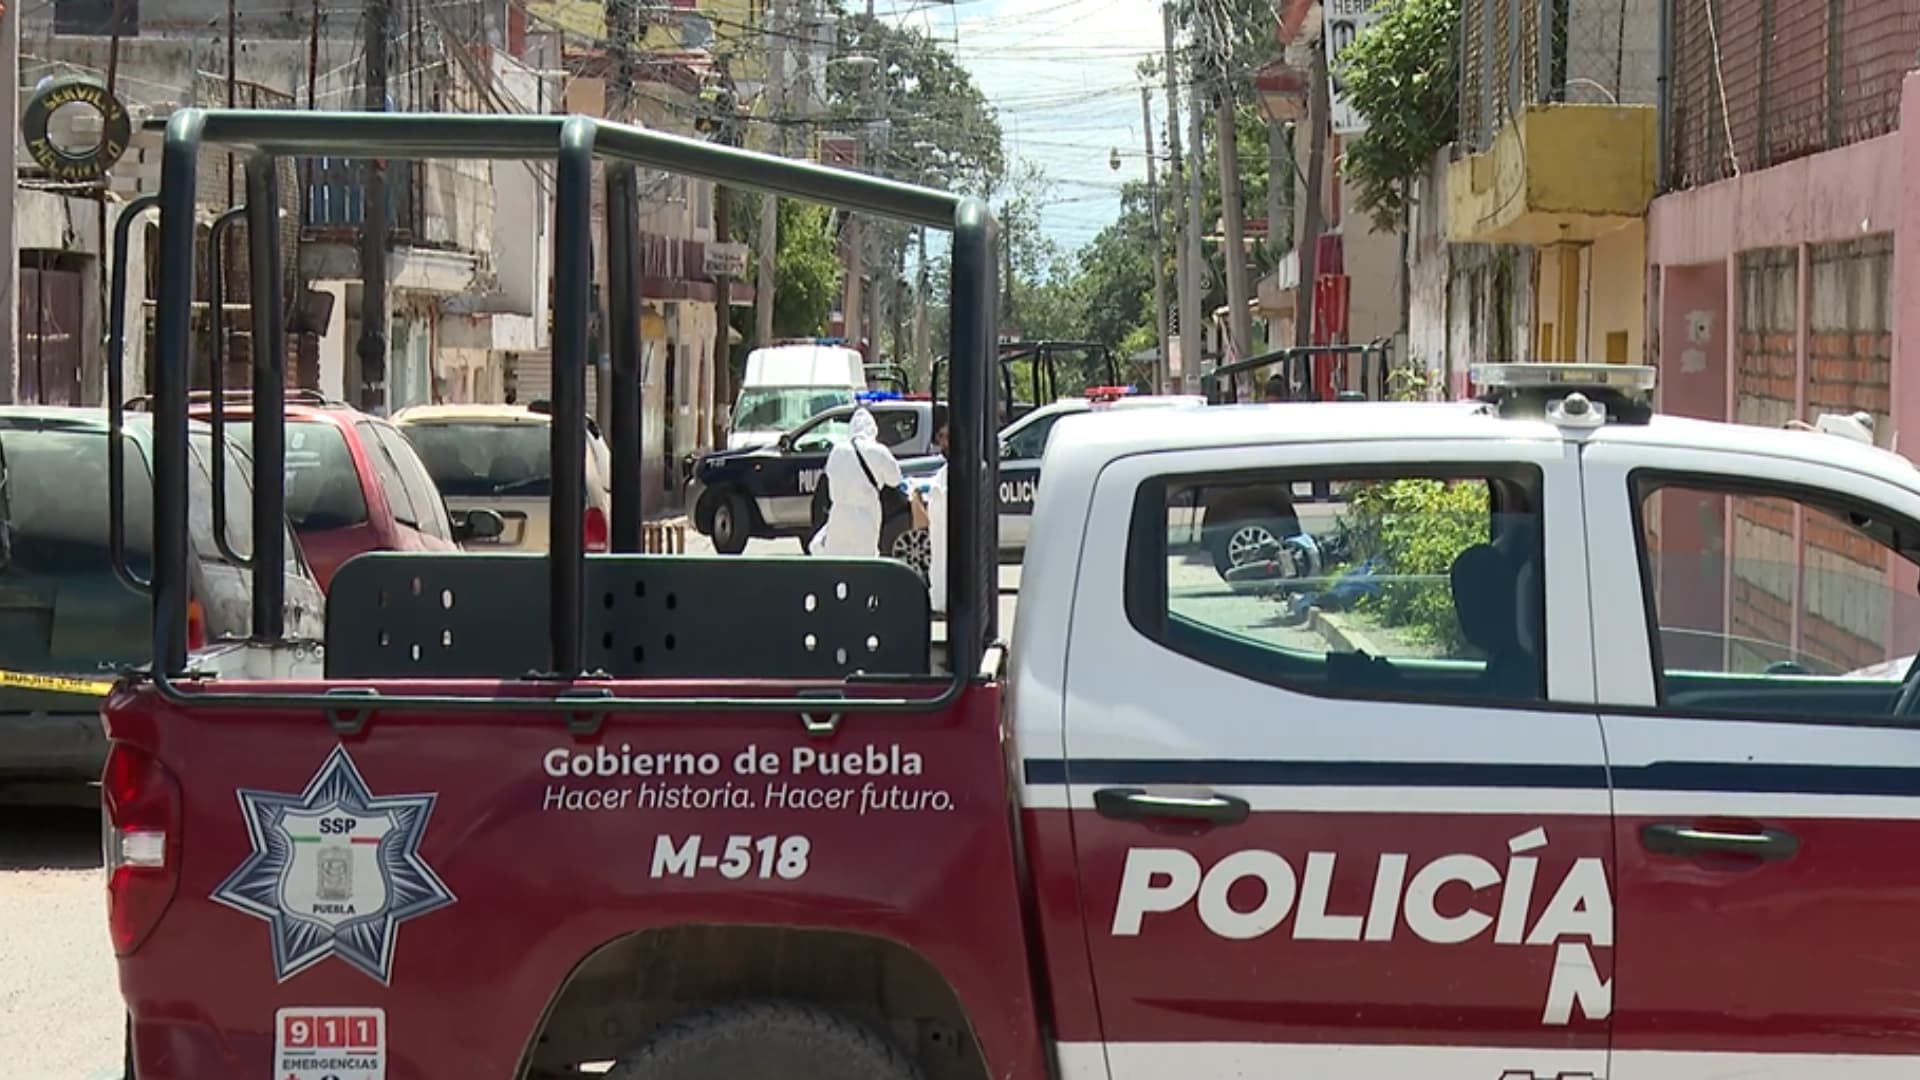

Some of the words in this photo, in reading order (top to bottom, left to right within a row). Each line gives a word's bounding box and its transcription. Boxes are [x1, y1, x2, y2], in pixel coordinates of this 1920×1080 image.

[543, 743, 721, 777] Gobierno
[733, 743, 780, 775] de
[792, 743, 923, 775] Puebla
[543, 784, 633, 811] Hacer
[637, 781, 757, 809] historia.
[764, 781, 855, 809] Hacer
[859, 781, 955, 816] futuro.
[319, 817, 357, 834] SSP
[650, 833, 811, 880] M-518
[1110, 825, 1615, 946] POLICÍA
[312, 903, 356, 915] PUEBLA
[290, 1020, 368, 1045] 911
[282, 1058, 378, 1071] EMERGENCIAS
